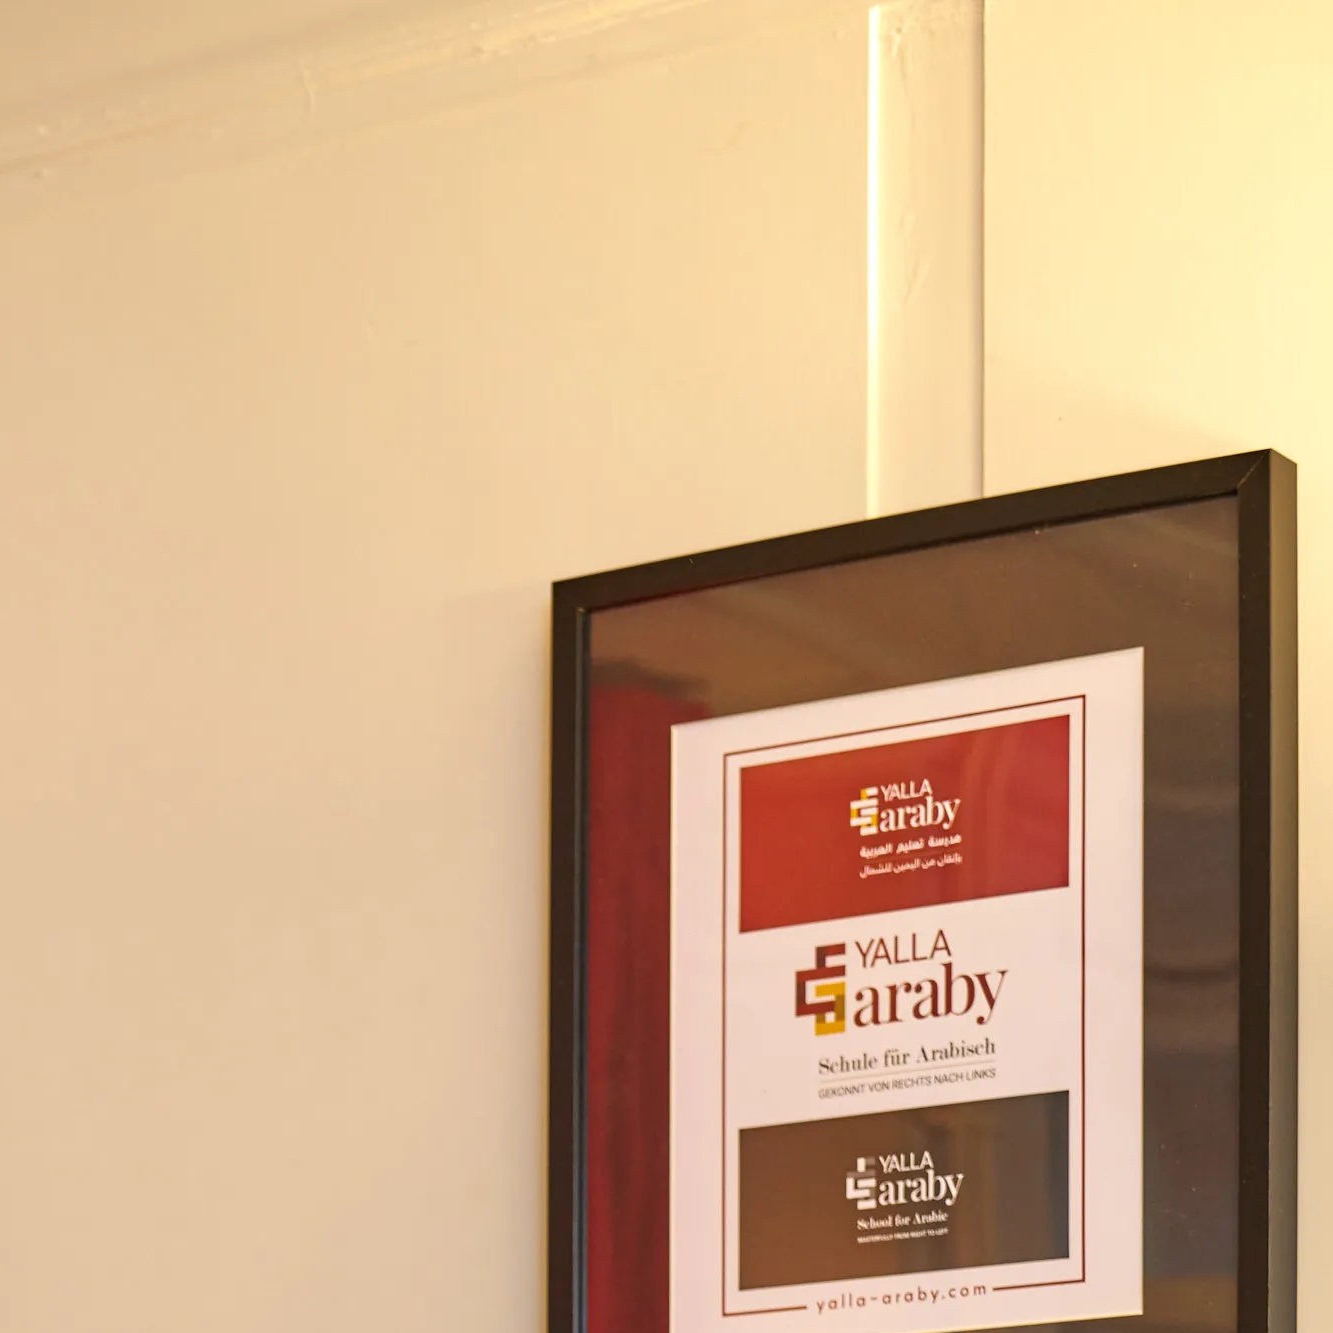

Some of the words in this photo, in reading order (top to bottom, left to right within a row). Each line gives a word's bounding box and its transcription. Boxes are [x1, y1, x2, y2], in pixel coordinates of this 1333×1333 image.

[880, 778, 934, 802] YALLA
[879, 795, 962, 832] araby
[854, 928, 952, 968] YALLA
[853, 961, 1009, 1028] araby
[818, 1053, 879, 1076] Schule
[883, 1048, 911, 1068] für
[915, 1037, 997, 1064] Arabisch
[818, 1084, 866, 1100] GEKONNT
[867, 1080, 890, 1093] VON
[892, 1074, 933, 1090] RECHTS
[933, 1071, 964, 1085] NACH
[966, 1067, 997, 1082] LINKS
[879, 1150, 934, 1174] YALLA
[878, 1168, 964, 1207] araby
[857, 1214, 893, 1230] School
[895, 1213, 912, 1227] for
[913, 1209, 949, 1225] Arabic
[816, 1283, 987, 1315] yalla-araby.com
